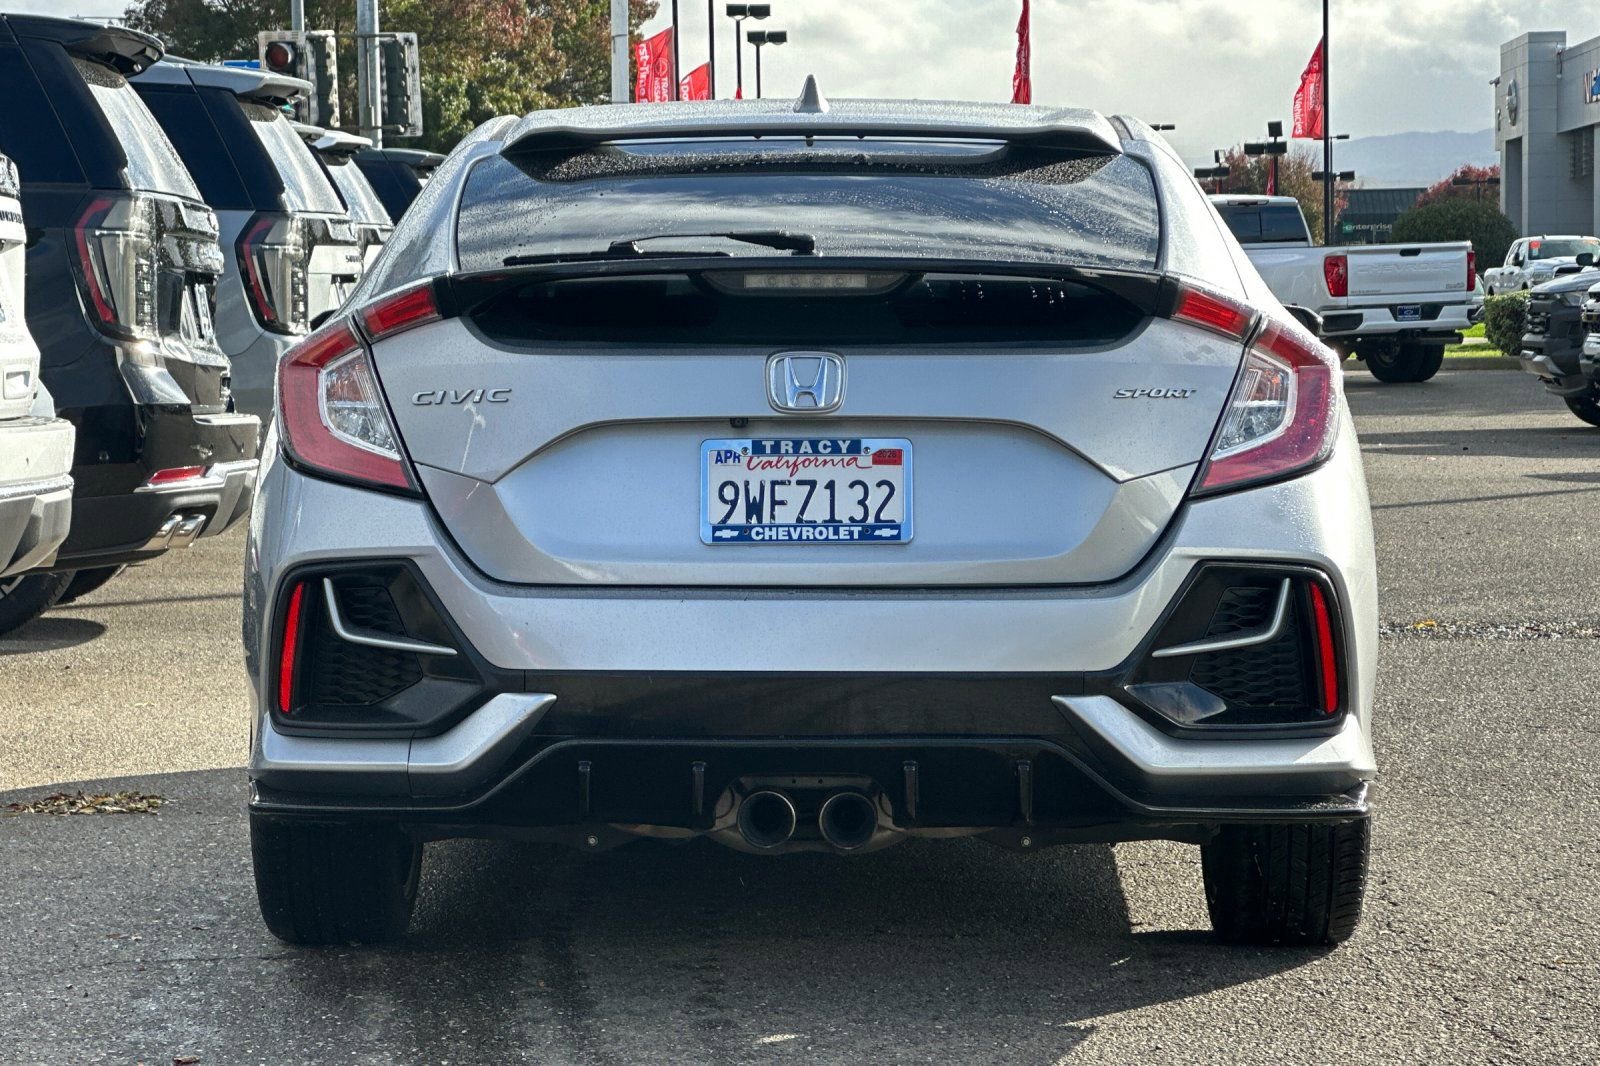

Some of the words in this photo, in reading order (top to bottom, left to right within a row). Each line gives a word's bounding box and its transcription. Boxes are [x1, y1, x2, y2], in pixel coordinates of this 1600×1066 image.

[661, 76, 669, 102] TRAC
[412, 388, 512, 406] CIVIC
[1112, 387, 1197, 399] SPORT
[761, 440, 852, 454] TRACY
[715, 450, 741, 464] APR
[746, 455, 872, 477] California
[717, 479, 897, 524] 9WFZ132
[751, 526, 862, 540] CHEVROLET
